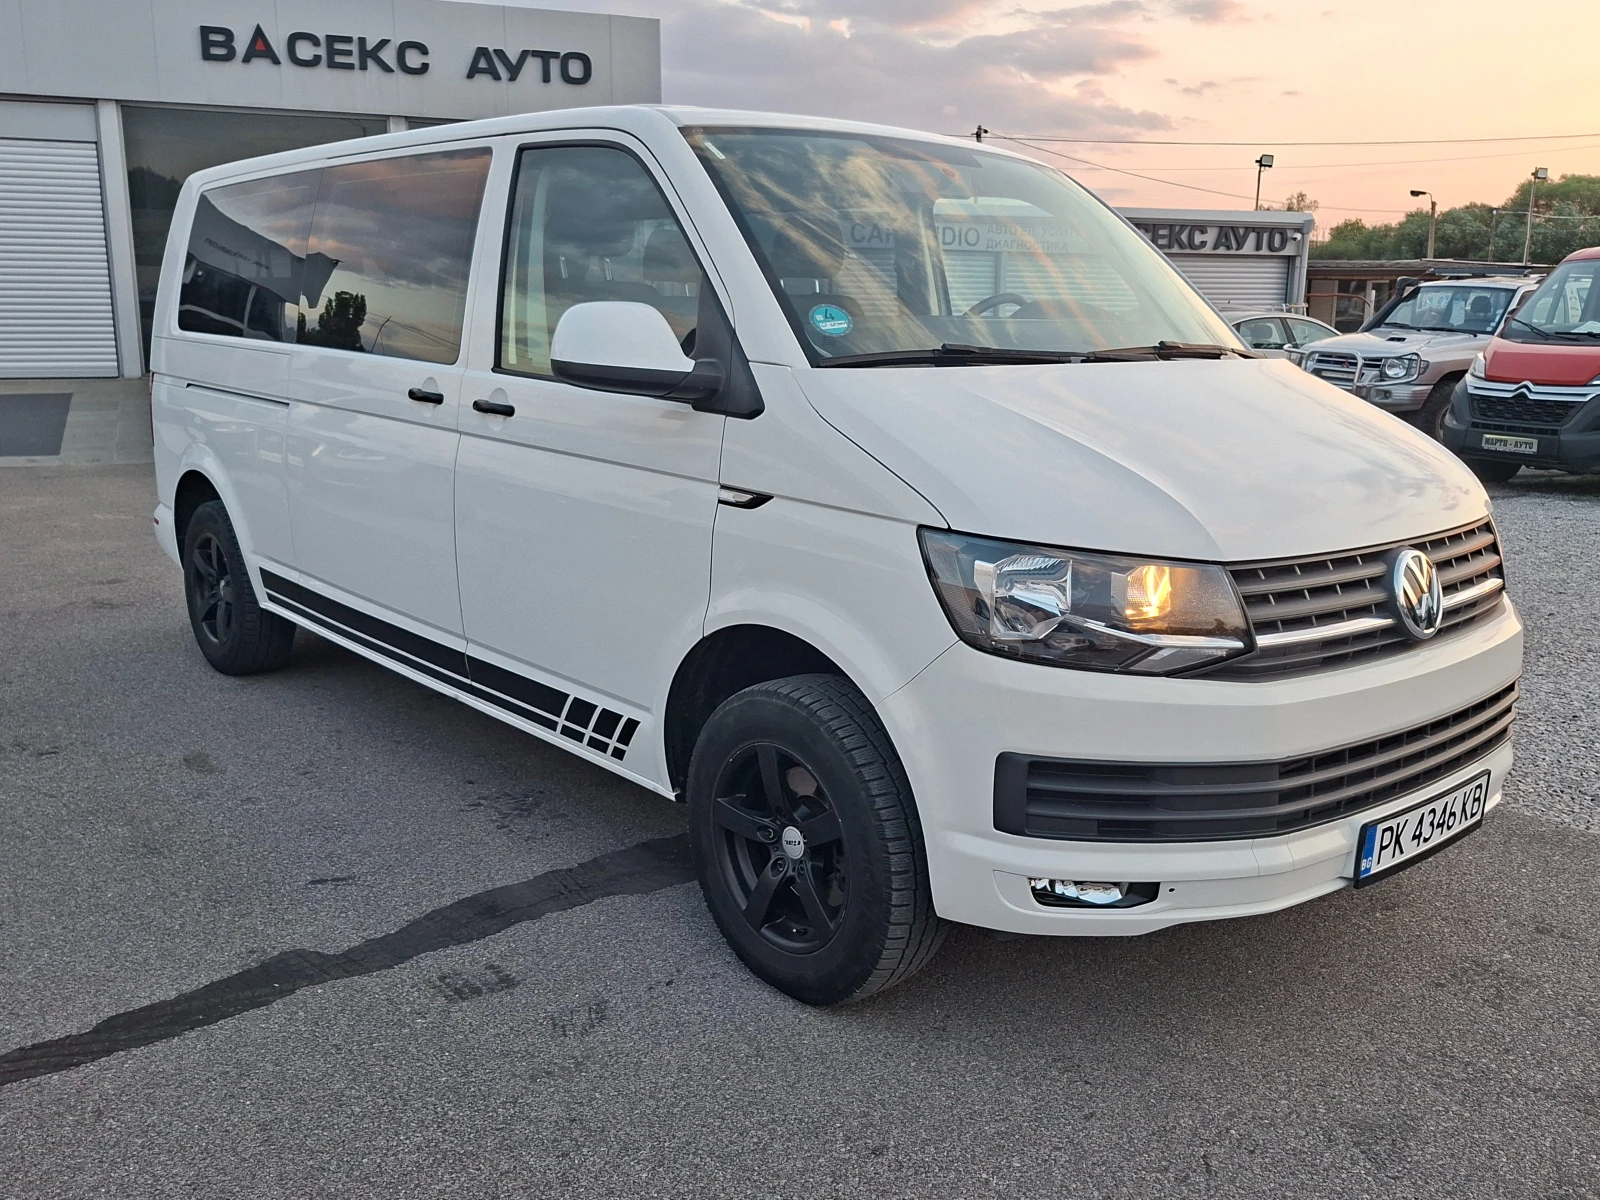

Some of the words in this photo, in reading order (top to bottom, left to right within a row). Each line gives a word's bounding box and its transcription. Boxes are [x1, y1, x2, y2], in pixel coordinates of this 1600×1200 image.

[200, 23, 430, 75] ВАСЕКС
[466, 46, 593, 85] АУТО
[1213, 226, 1288, 252] АУТО
[1377, 818, 1409, 866] PK
[1411, 795, 1458, 848] 4346
[1458, 782, 1483, 826] KB
[1361, 856, 1372, 871] BG
